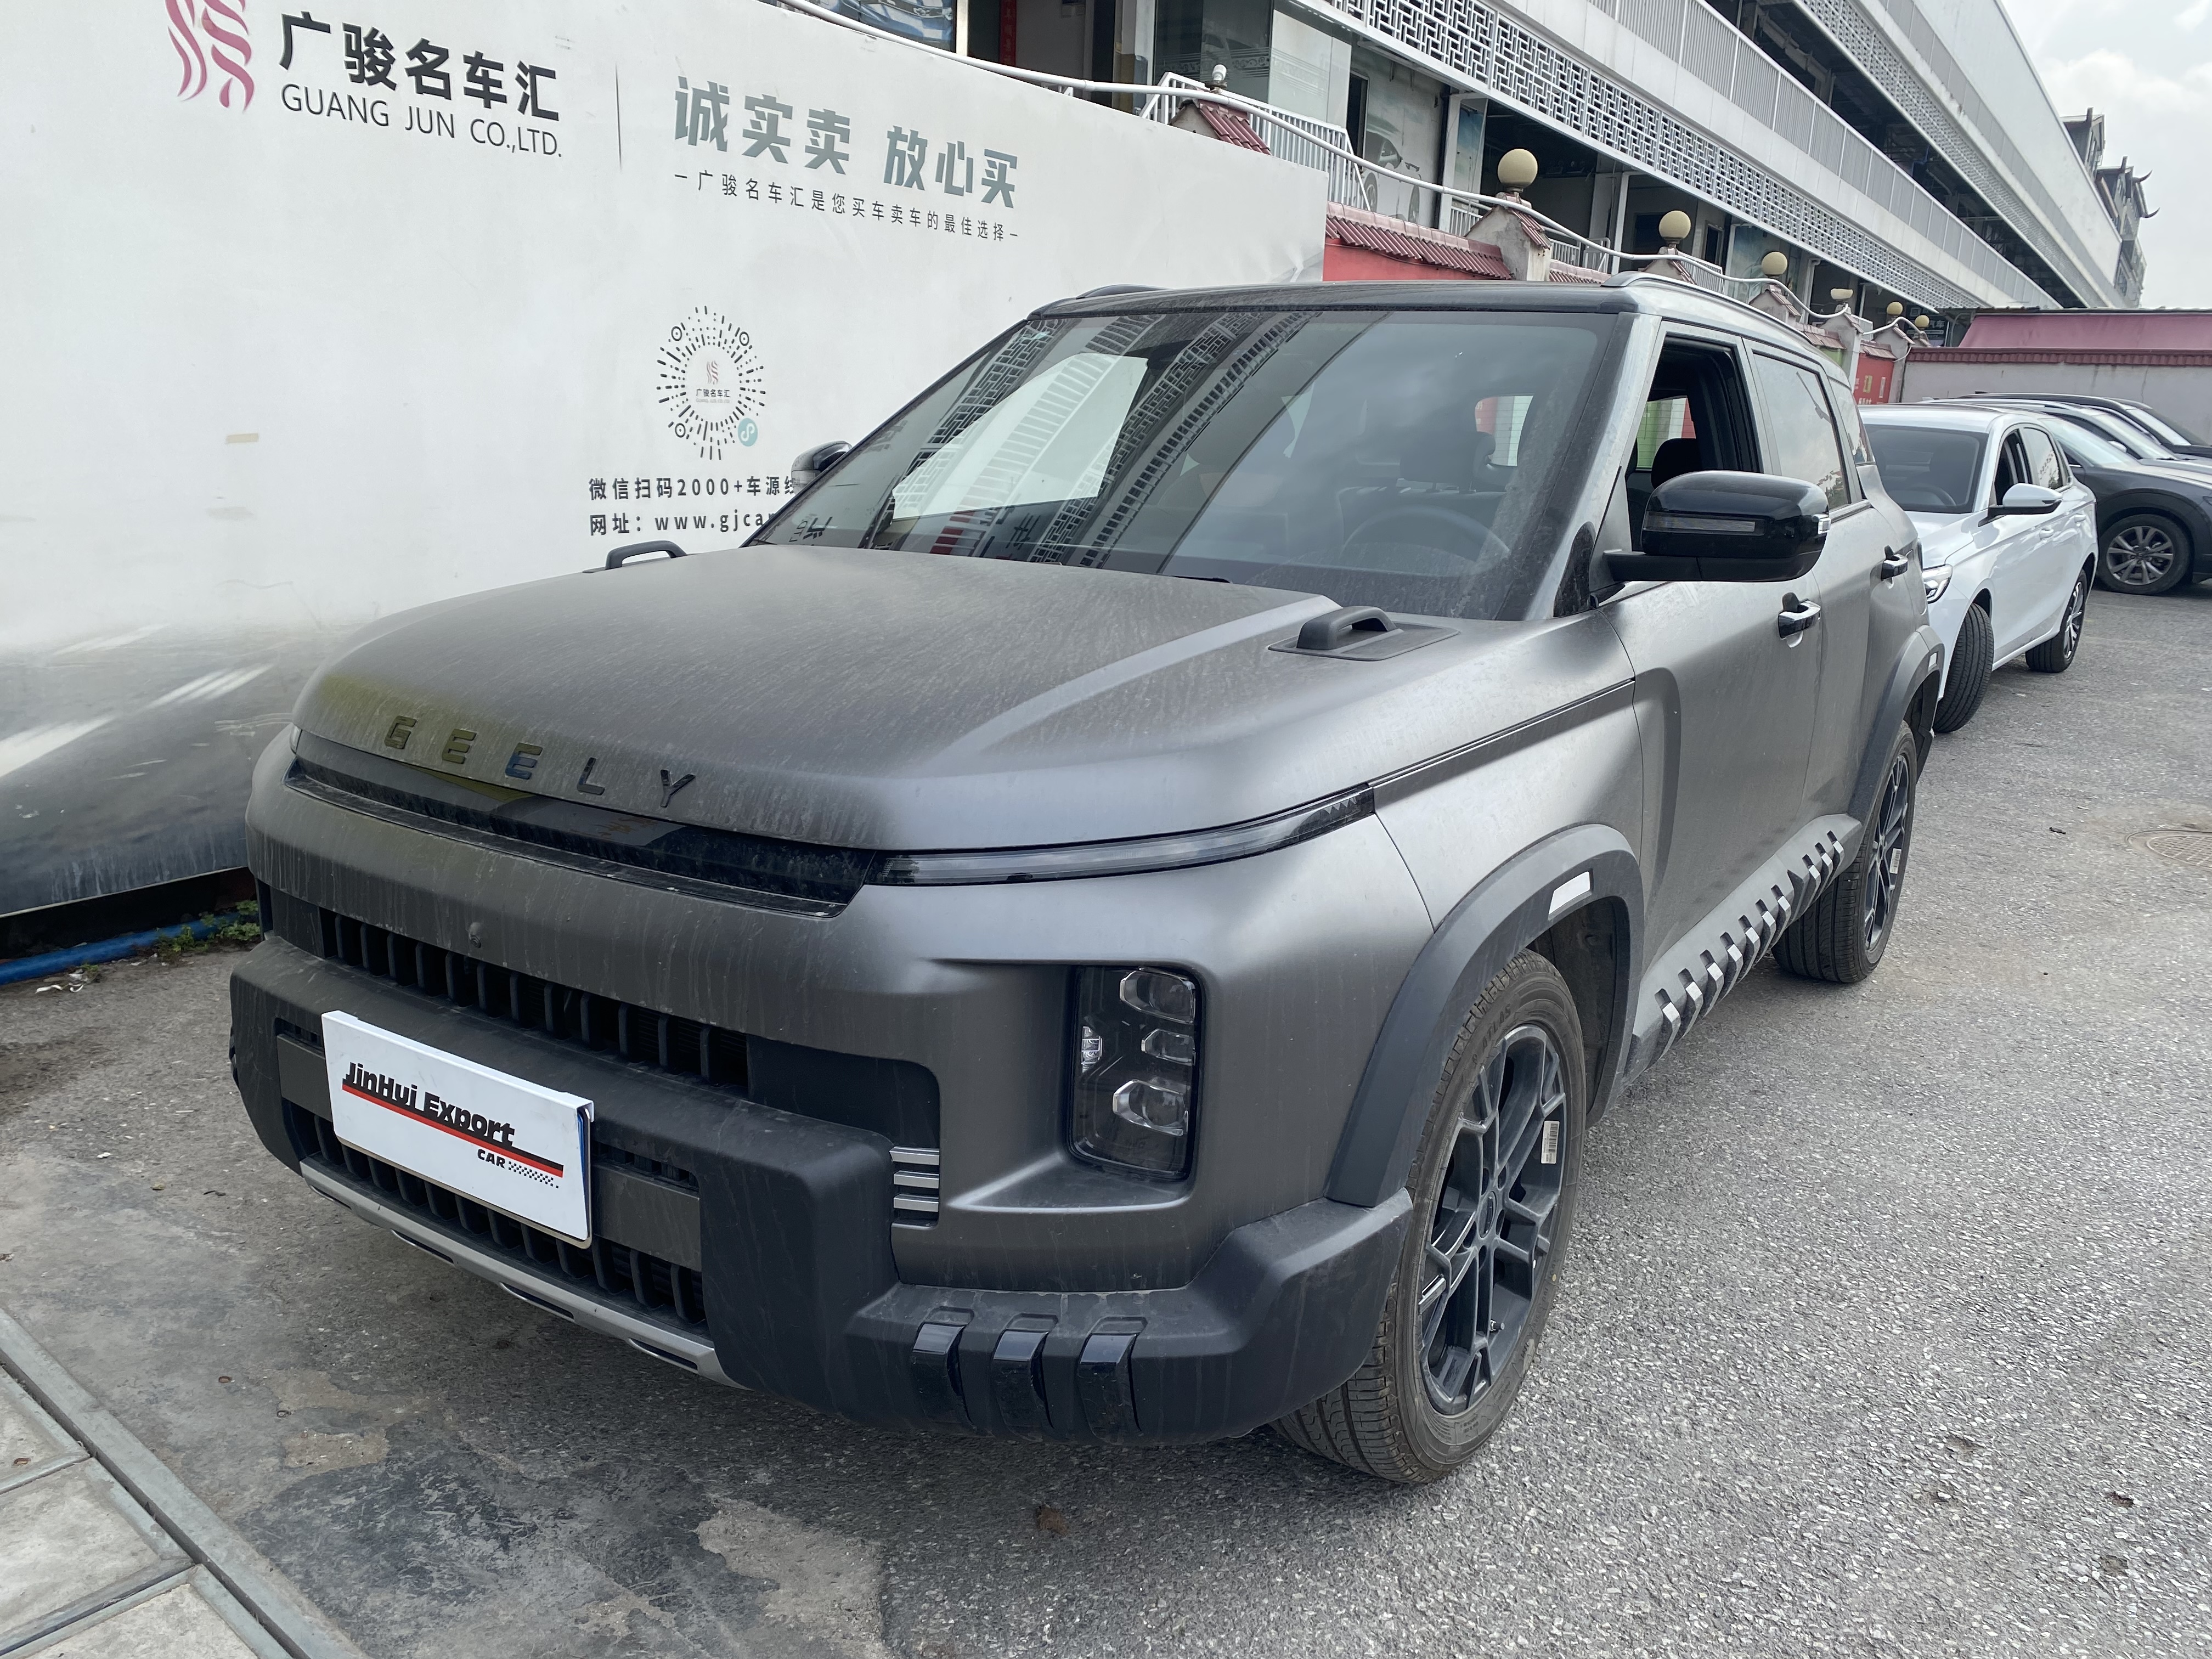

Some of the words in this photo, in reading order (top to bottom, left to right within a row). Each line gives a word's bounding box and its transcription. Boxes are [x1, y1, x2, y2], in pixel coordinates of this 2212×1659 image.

[279, 11, 560, 121] 广骏名车汇
[281, 83, 389, 127] GUANG
[405, 105, 455, 139] JUN
[470, 119, 562, 157] CO.,LTD.
[674, 76, 850, 176] 诚实卖
[883, 125, 1018, 208] 放心买
[384, 715, 696, 808] GEELY
[345, 1062, 418, 1110] JinHui
[424, 1091, 515, 1147] Export
[477, 1149, 505, 1169] CAR
